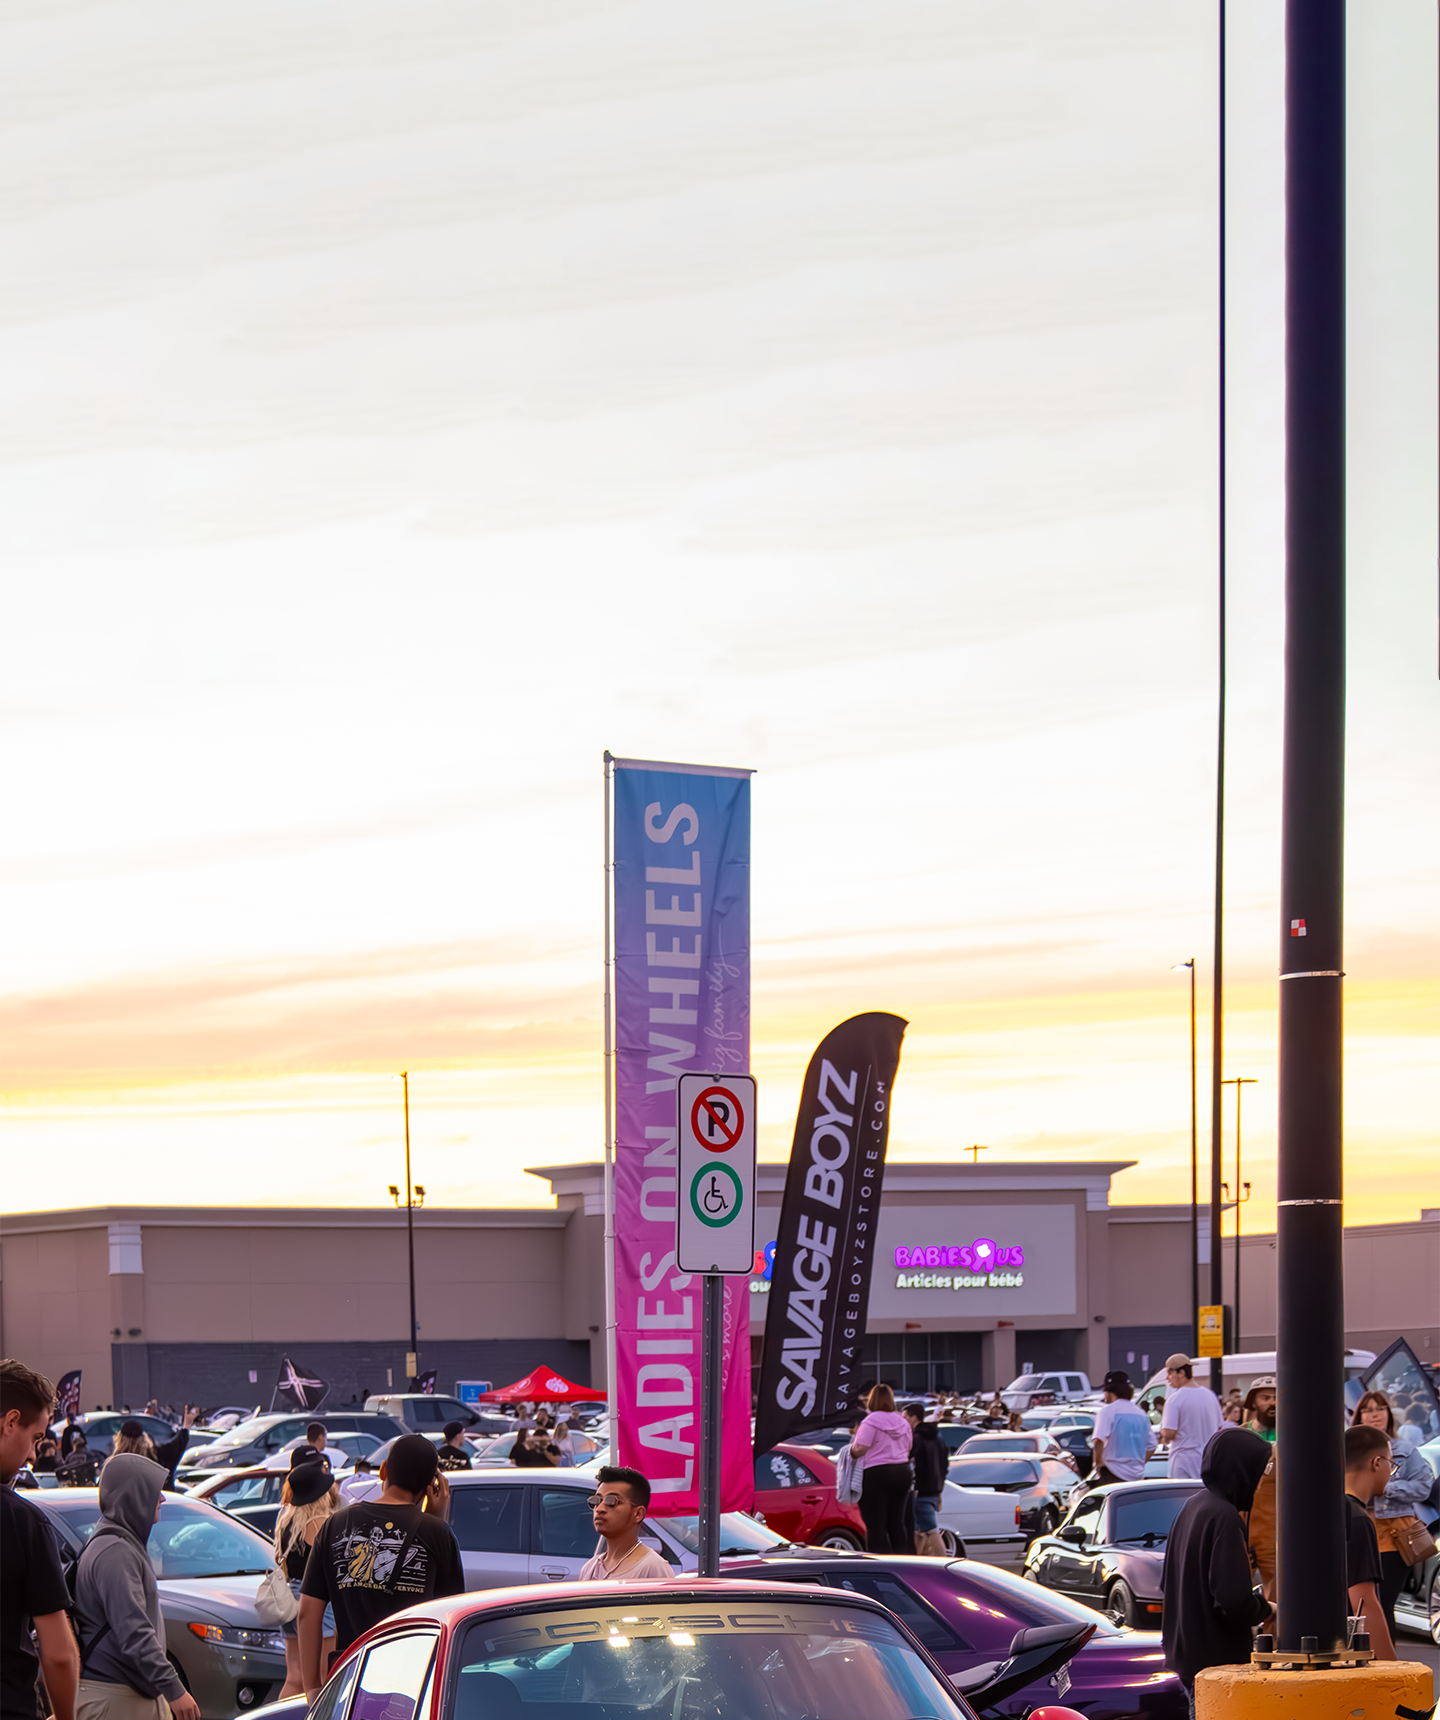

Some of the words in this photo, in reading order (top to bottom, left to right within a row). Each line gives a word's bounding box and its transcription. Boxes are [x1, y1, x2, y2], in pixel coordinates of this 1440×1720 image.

[643, 801, 702, 1095] WHEELS
[703, 924, 743, 1041] family
[803, 1058, 858, 1210] BOYZ
[776, 1214, 838, 1417] SAVAGE
[835, 1080, 886, 1411] SAVAGEBOYZSTORE.COM
[896, 1273, 952, 1288] Articles
[953, 1276, 987, 1290] pour
[989, 1272, 1023, 1287] bébé
[636, 1250, 696, 1494] LADIES
[487, 1613, 896, 1653] PORSCHE
